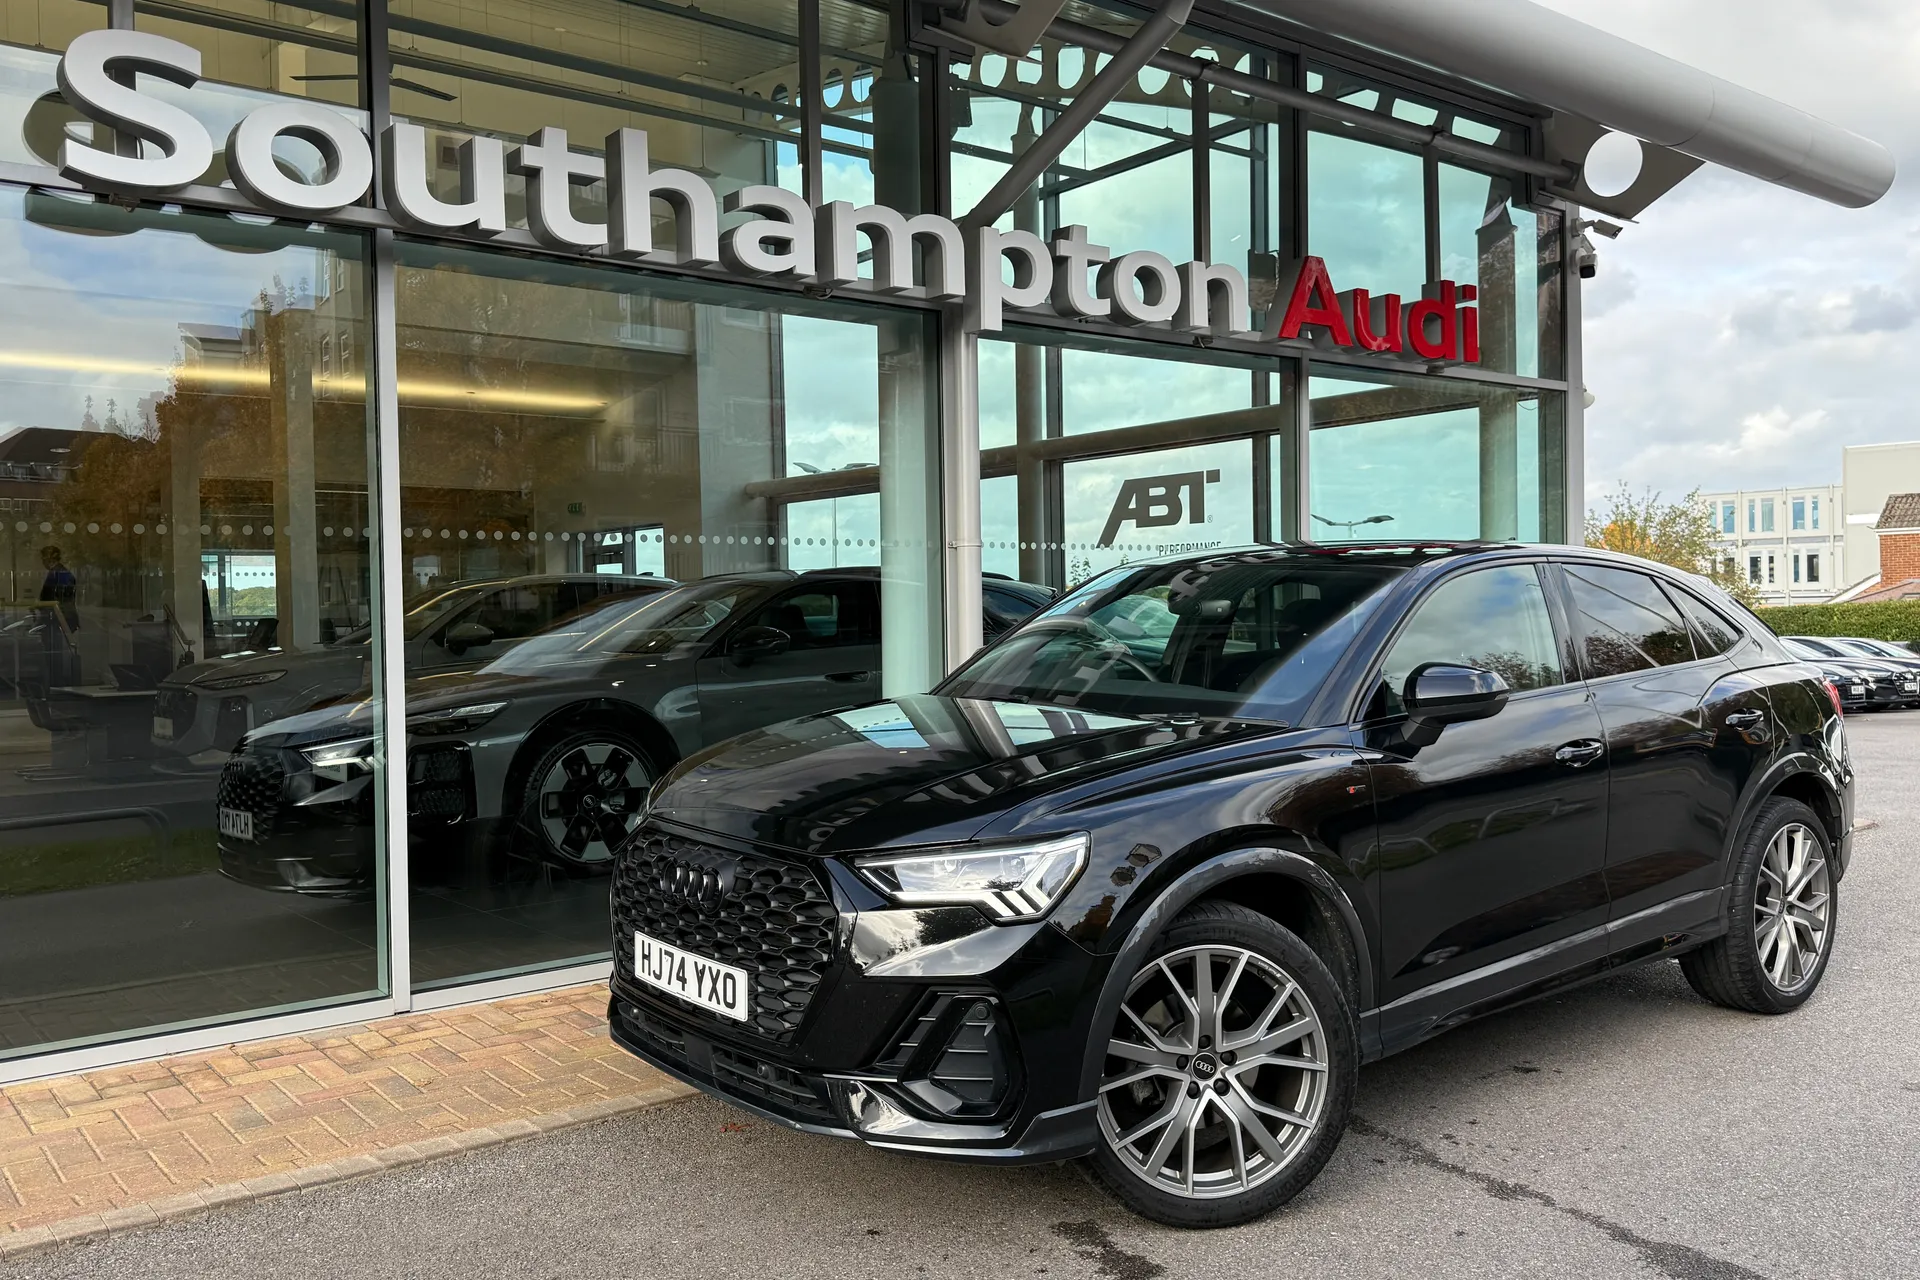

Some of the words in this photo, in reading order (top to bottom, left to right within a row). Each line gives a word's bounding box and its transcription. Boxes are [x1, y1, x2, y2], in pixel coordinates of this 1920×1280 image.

[57, 29, 1250, 333] Southampton
[1278, 255, 1480, 363] Audi
[1095, 468, 1221, 549] ABT
[641, 939, 687, 992] HJ74
[693, 960, 737, 1010] YXO
